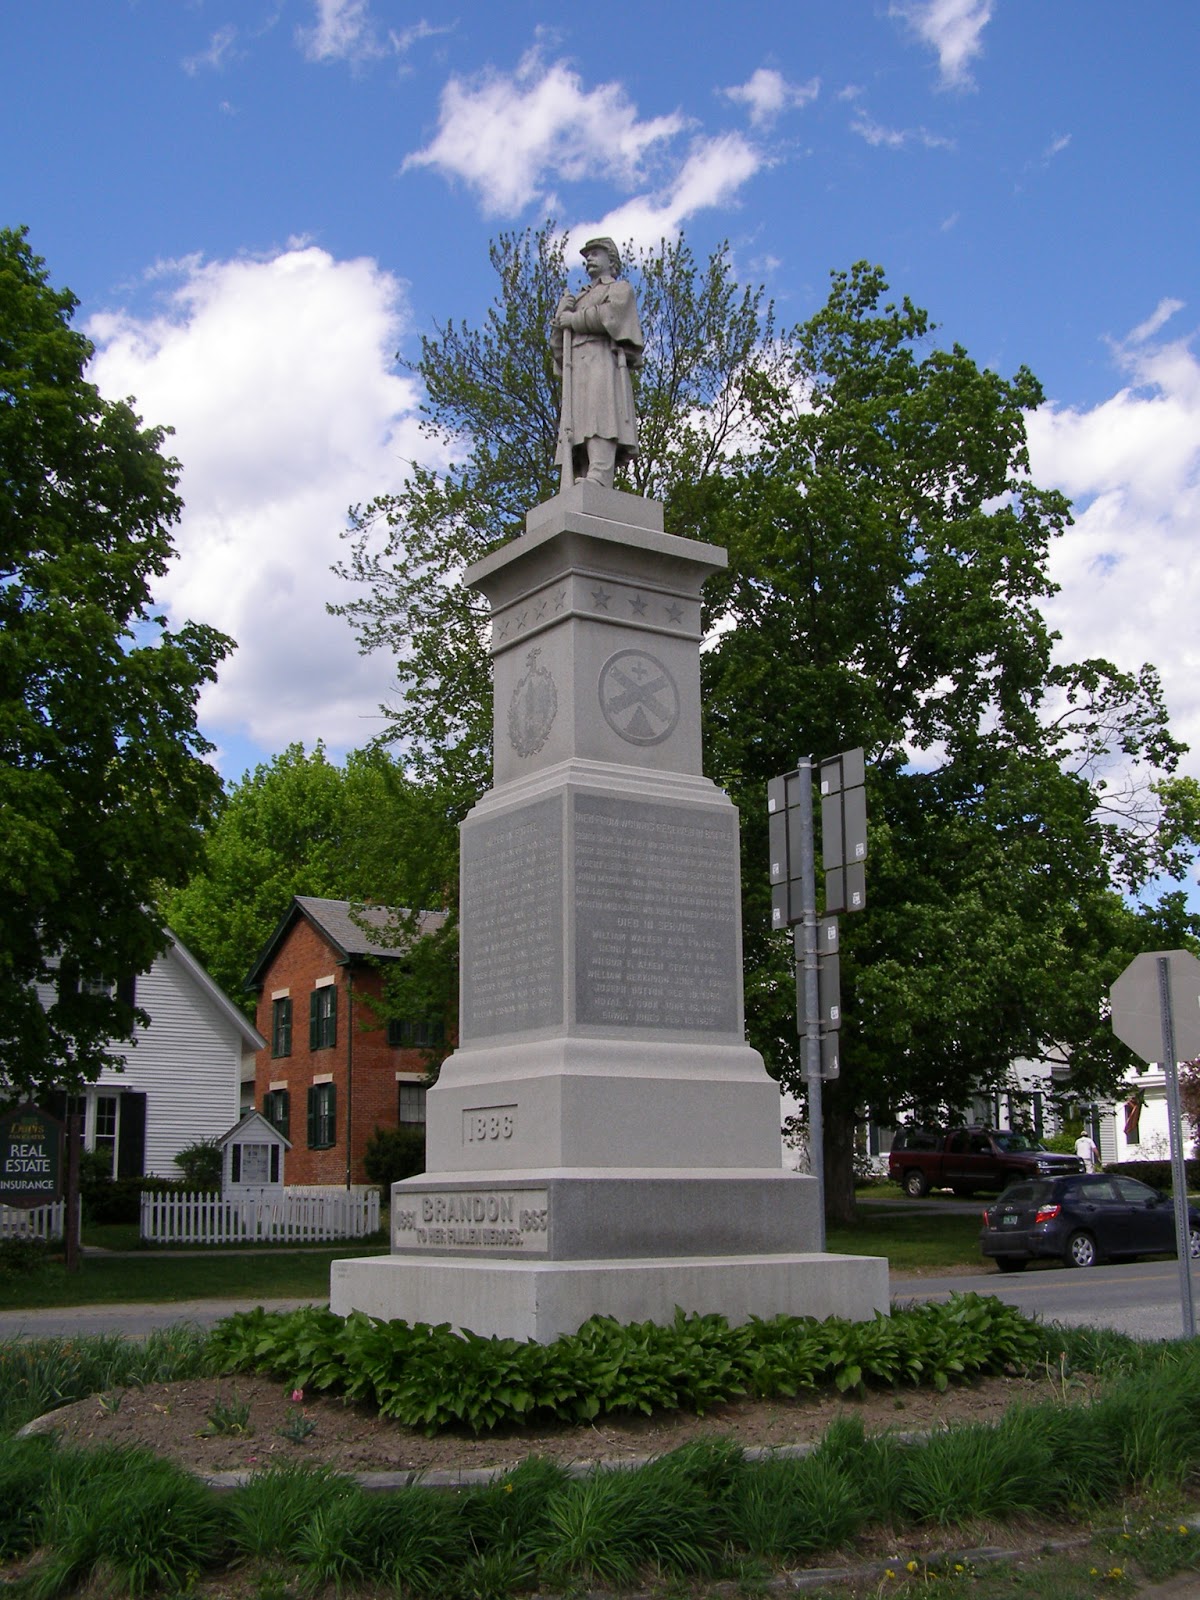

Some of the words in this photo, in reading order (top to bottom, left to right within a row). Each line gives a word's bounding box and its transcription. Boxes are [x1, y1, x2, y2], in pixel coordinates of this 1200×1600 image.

[468, 1117, 514, 1142] 1886
[10, 1144, 47, 1157] REAL
[5, 1159, 51, 1172] ESTATE
[0, 1180, 54, 1190] INSURANCE
[423, 1197, 513, 1222] BRANDON
[417, 1228, 428, 1243] TO
[447, 1228, 482, 1245] FALLEN
